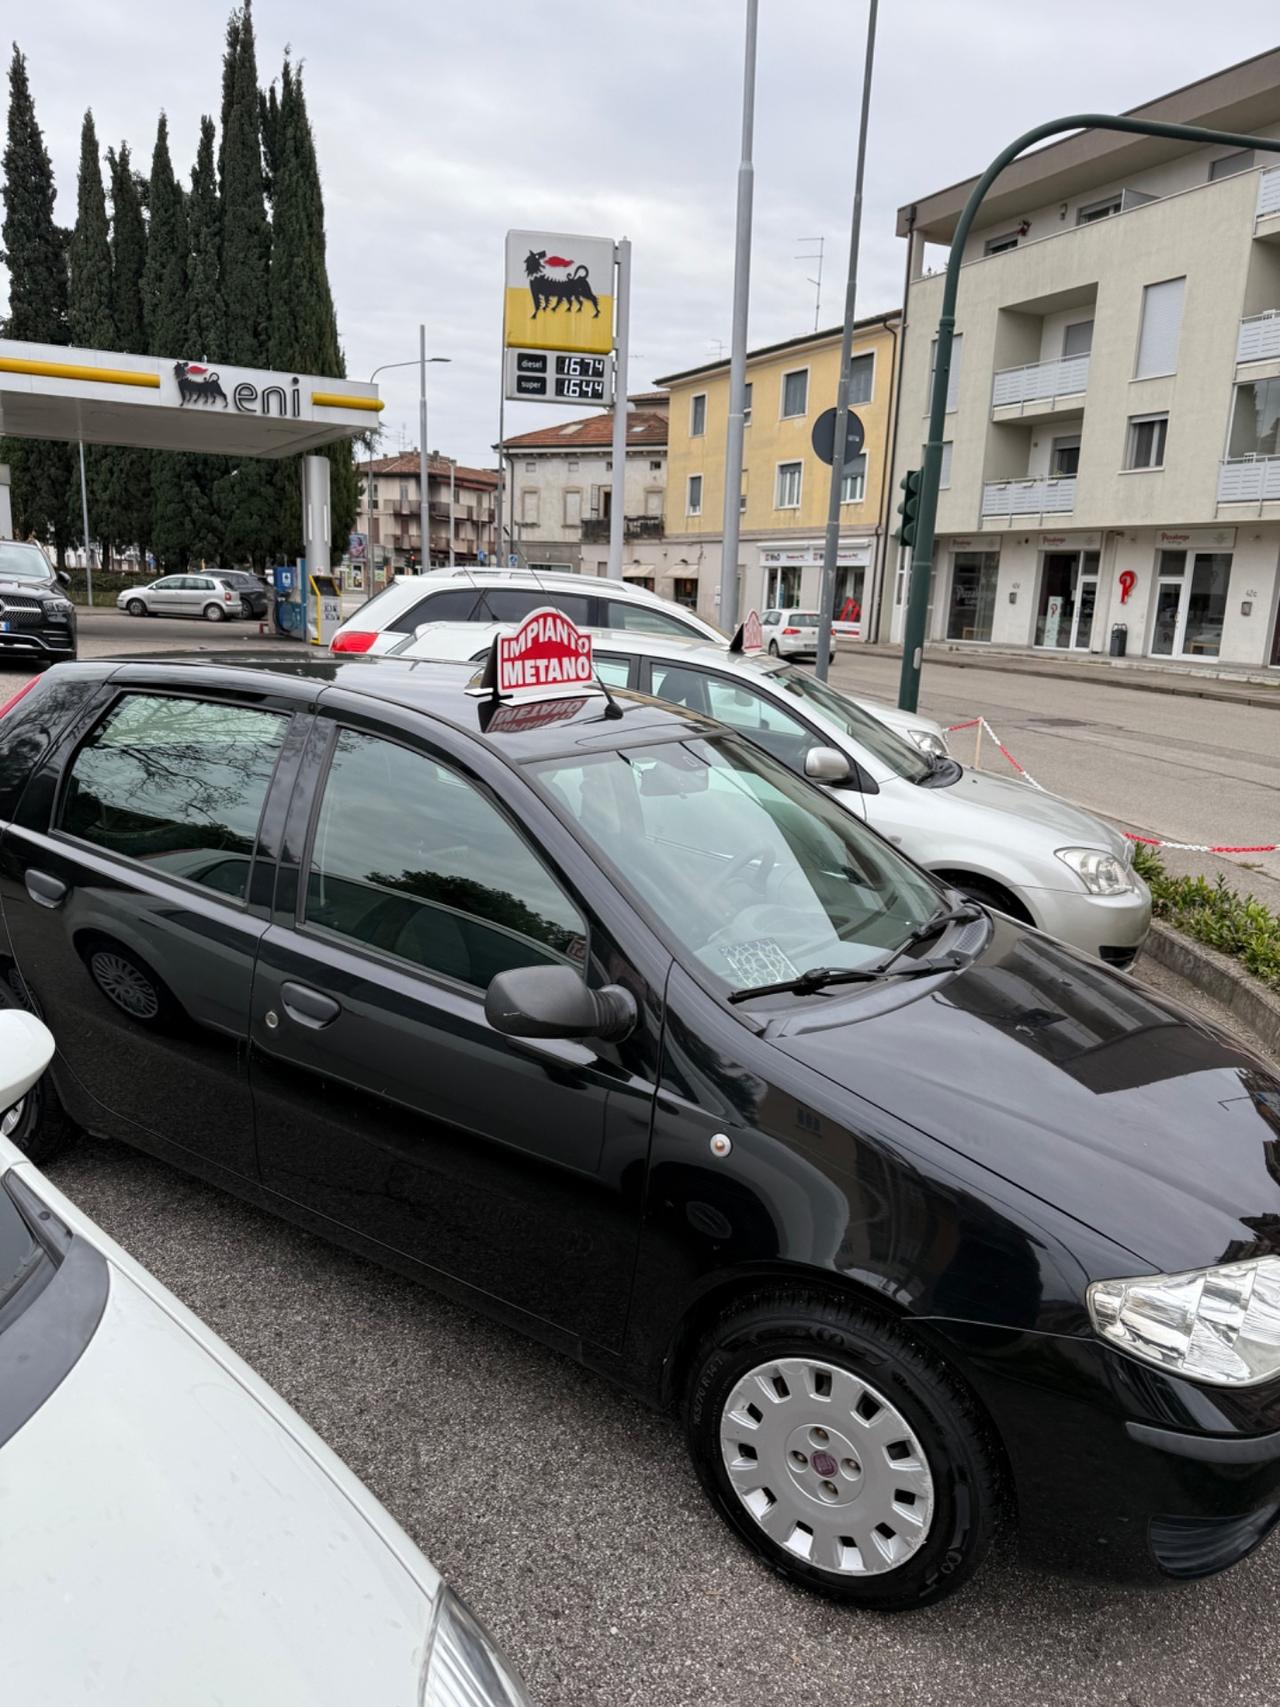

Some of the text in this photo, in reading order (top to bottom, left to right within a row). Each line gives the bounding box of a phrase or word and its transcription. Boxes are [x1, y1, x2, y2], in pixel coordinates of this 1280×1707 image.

[521, 360, 542, 369] diesel
[234, 377, 300, 417] eni
[521, 381, 541, 390] super
[503, 617, 590, 659] IMPIANTO
[503, 656, 590, 687] METANO
